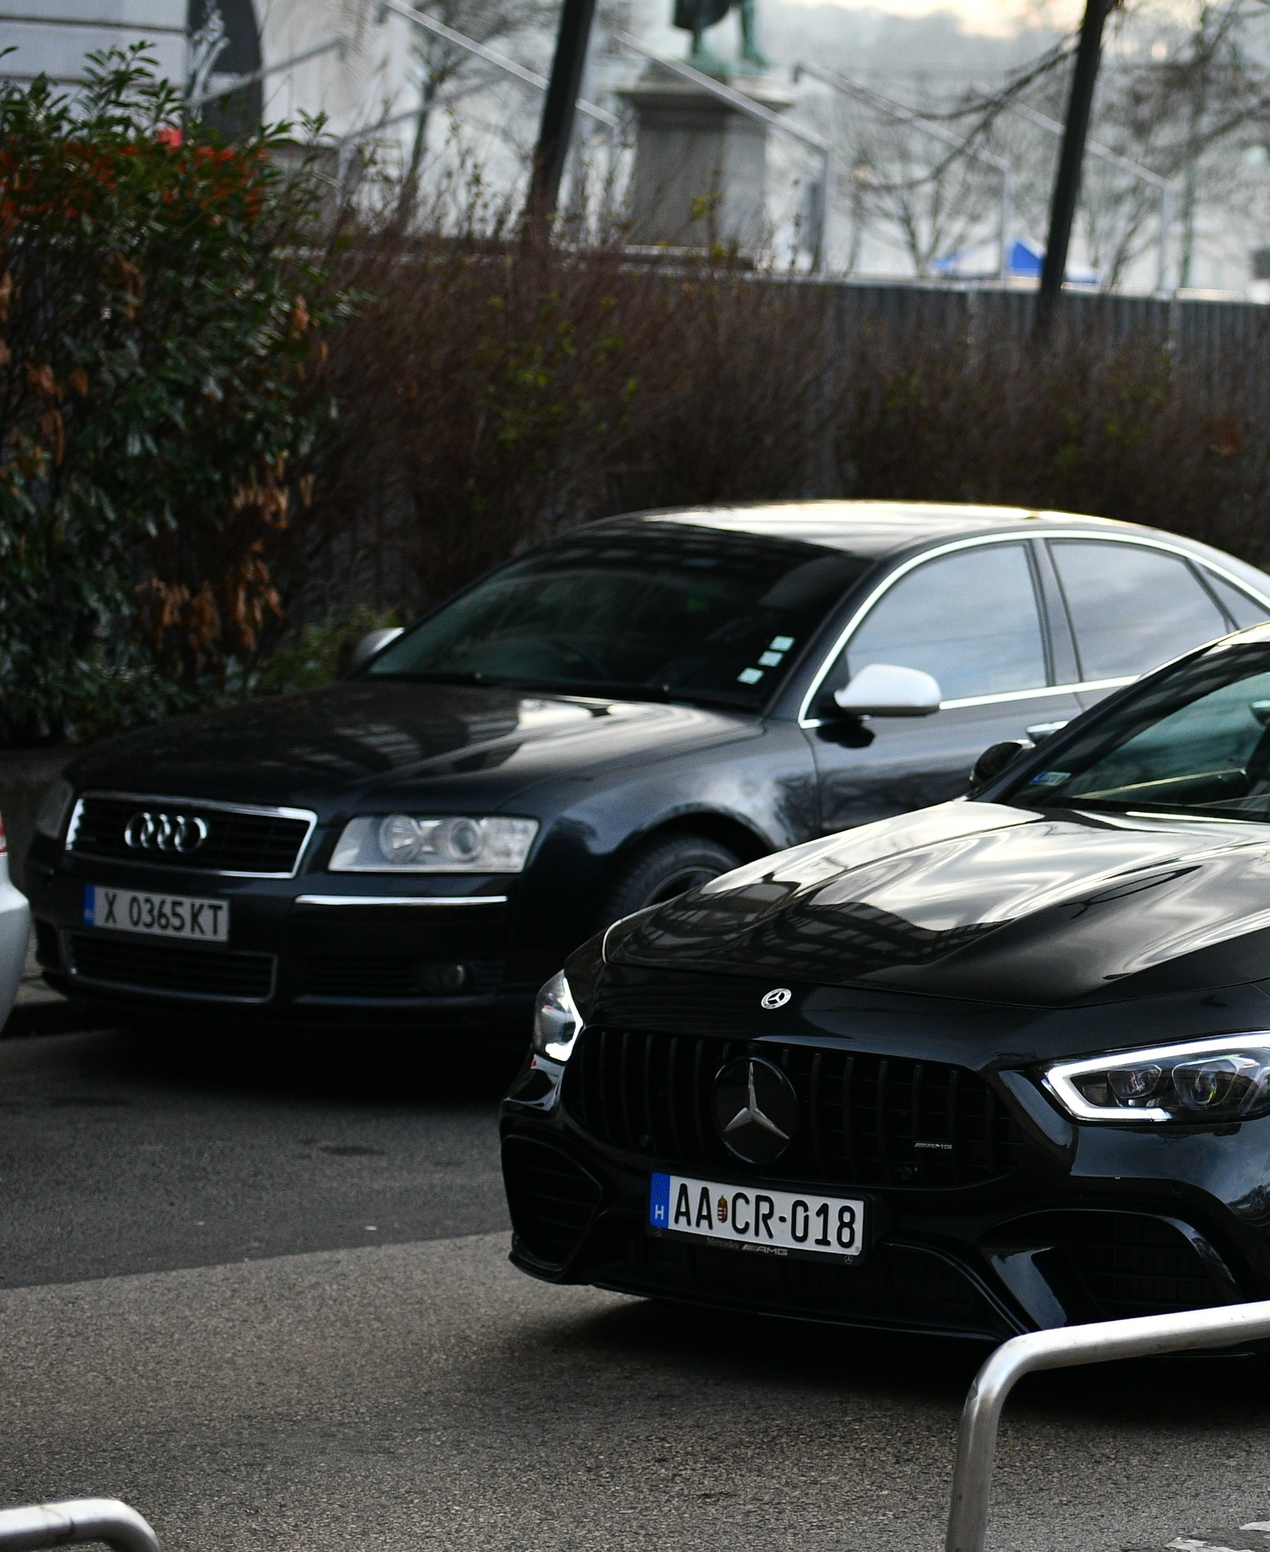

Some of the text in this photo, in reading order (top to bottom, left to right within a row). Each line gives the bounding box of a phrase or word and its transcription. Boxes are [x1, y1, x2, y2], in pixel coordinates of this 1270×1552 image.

[104, 892, 117, 924] X
[654, 1204, 665, 1221] H
[756, 1246, 789, 1256] AMG
